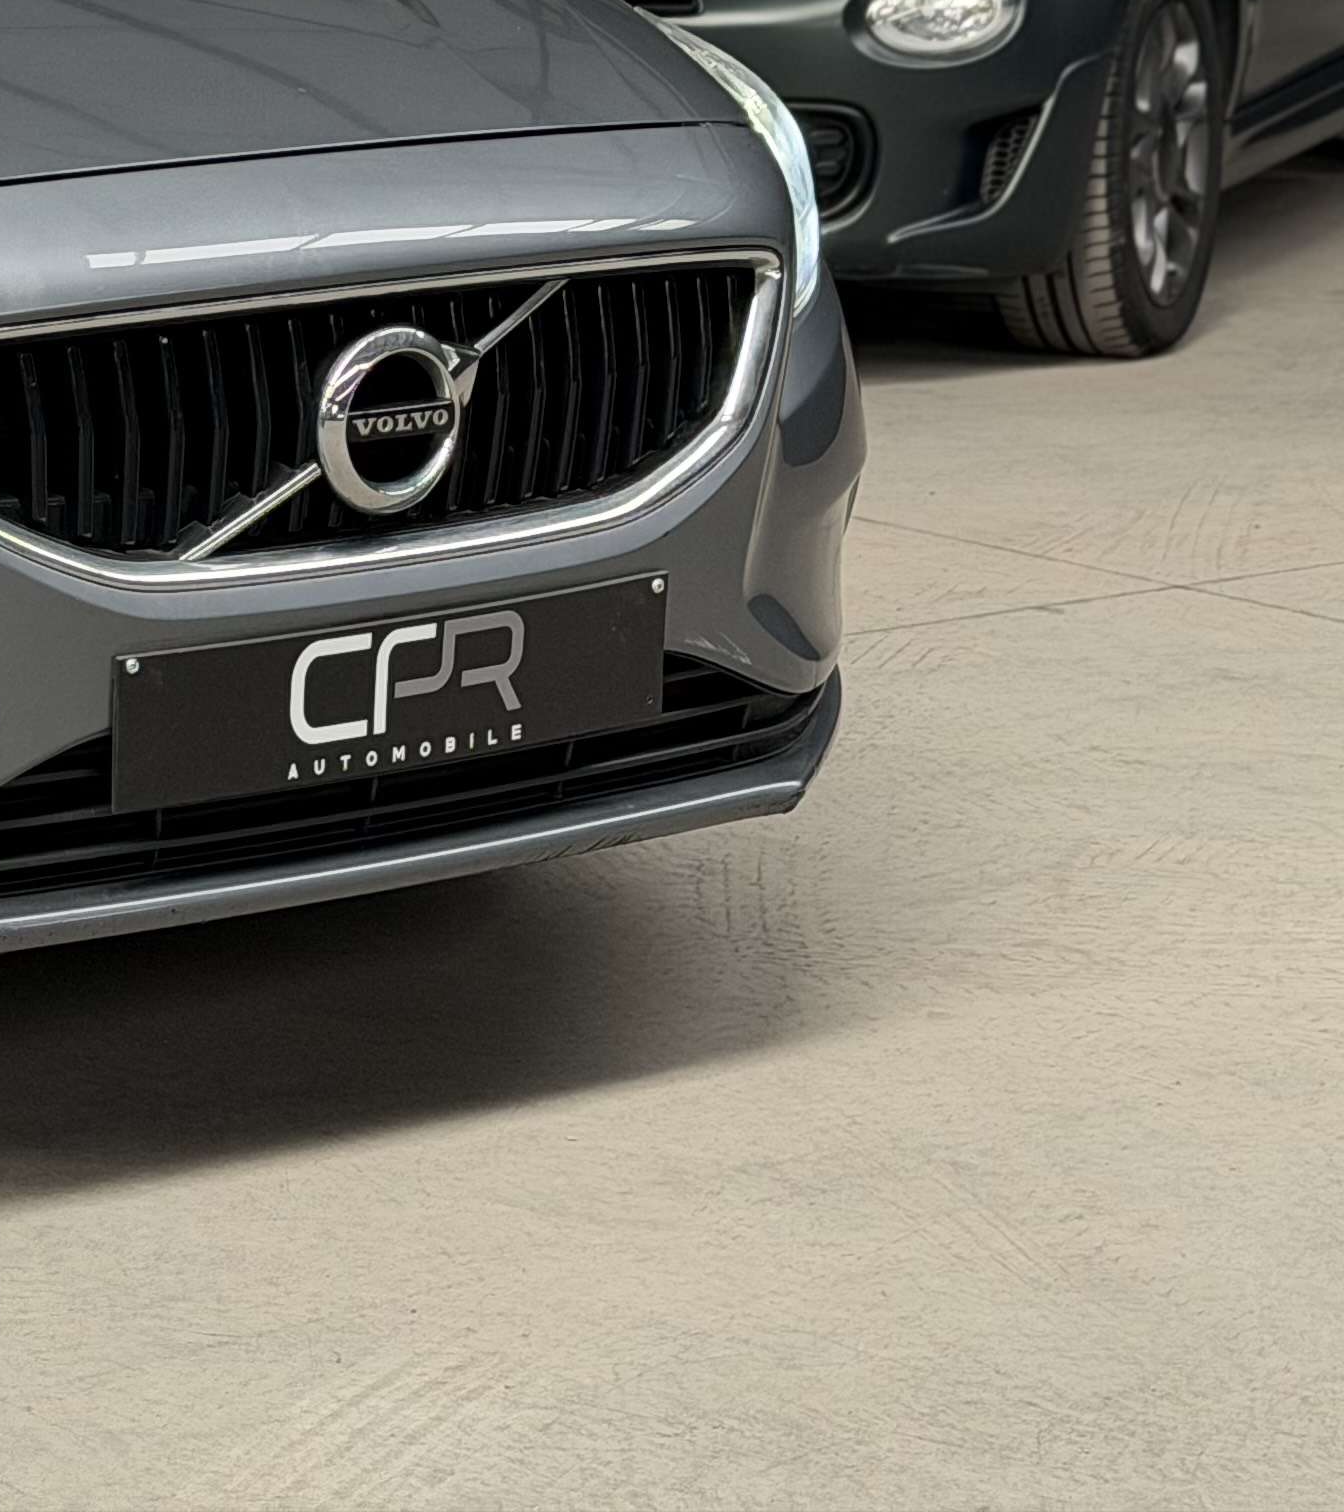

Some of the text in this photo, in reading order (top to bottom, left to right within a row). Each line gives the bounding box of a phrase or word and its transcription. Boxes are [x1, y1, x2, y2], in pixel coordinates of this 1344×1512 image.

[352, 409, 449, 436] VOLVO
[289, 610, 525, 745] CPR
[287, 723, 523, 780] AUTOMOBILE
